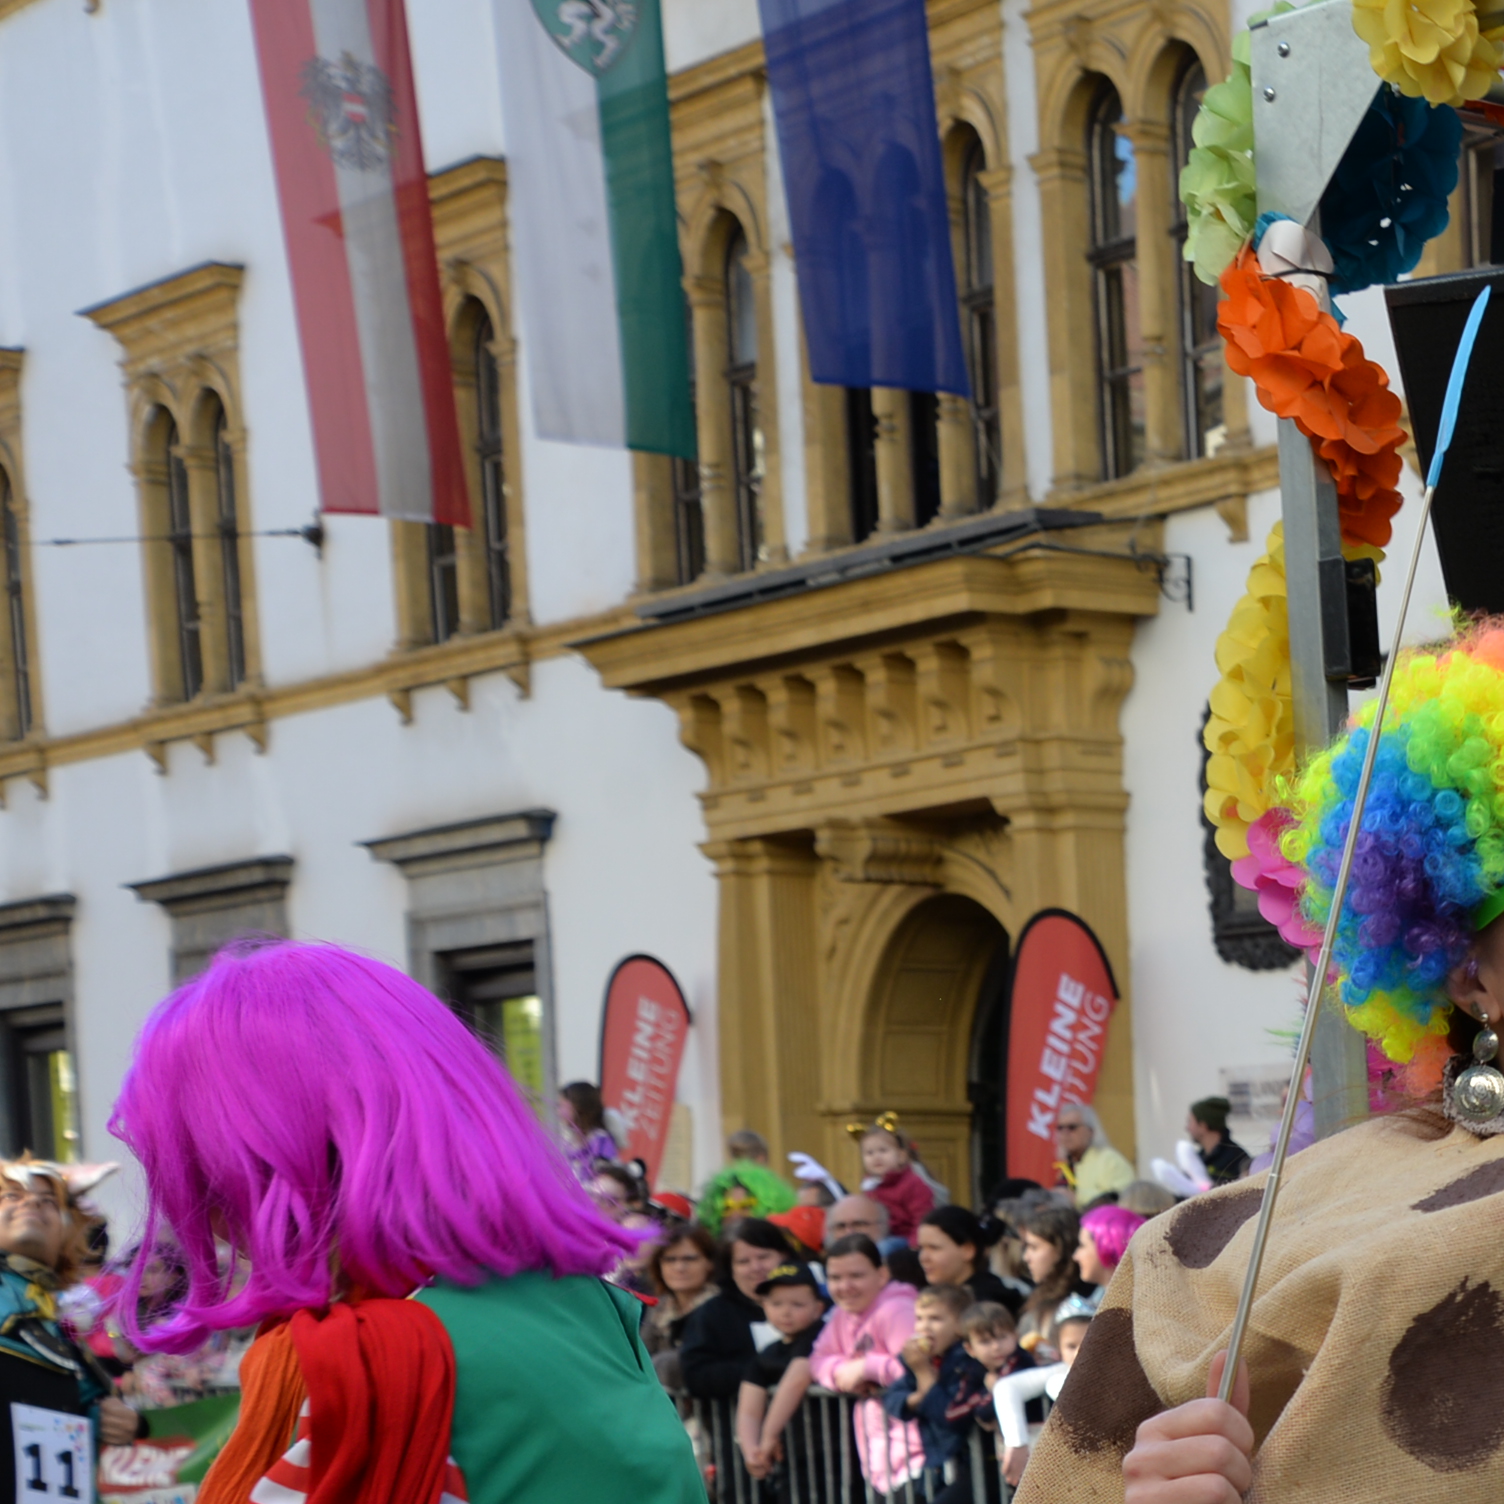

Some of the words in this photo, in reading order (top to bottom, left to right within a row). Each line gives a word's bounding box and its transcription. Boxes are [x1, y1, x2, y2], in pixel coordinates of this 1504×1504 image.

[618, 995, 661, 1131] KLEINE
[1026, 973, 1085, 1140] KLEINE
[1061, 992, 1110, 1107] ITUNG
[22, 1444, 79, 1498] 11
